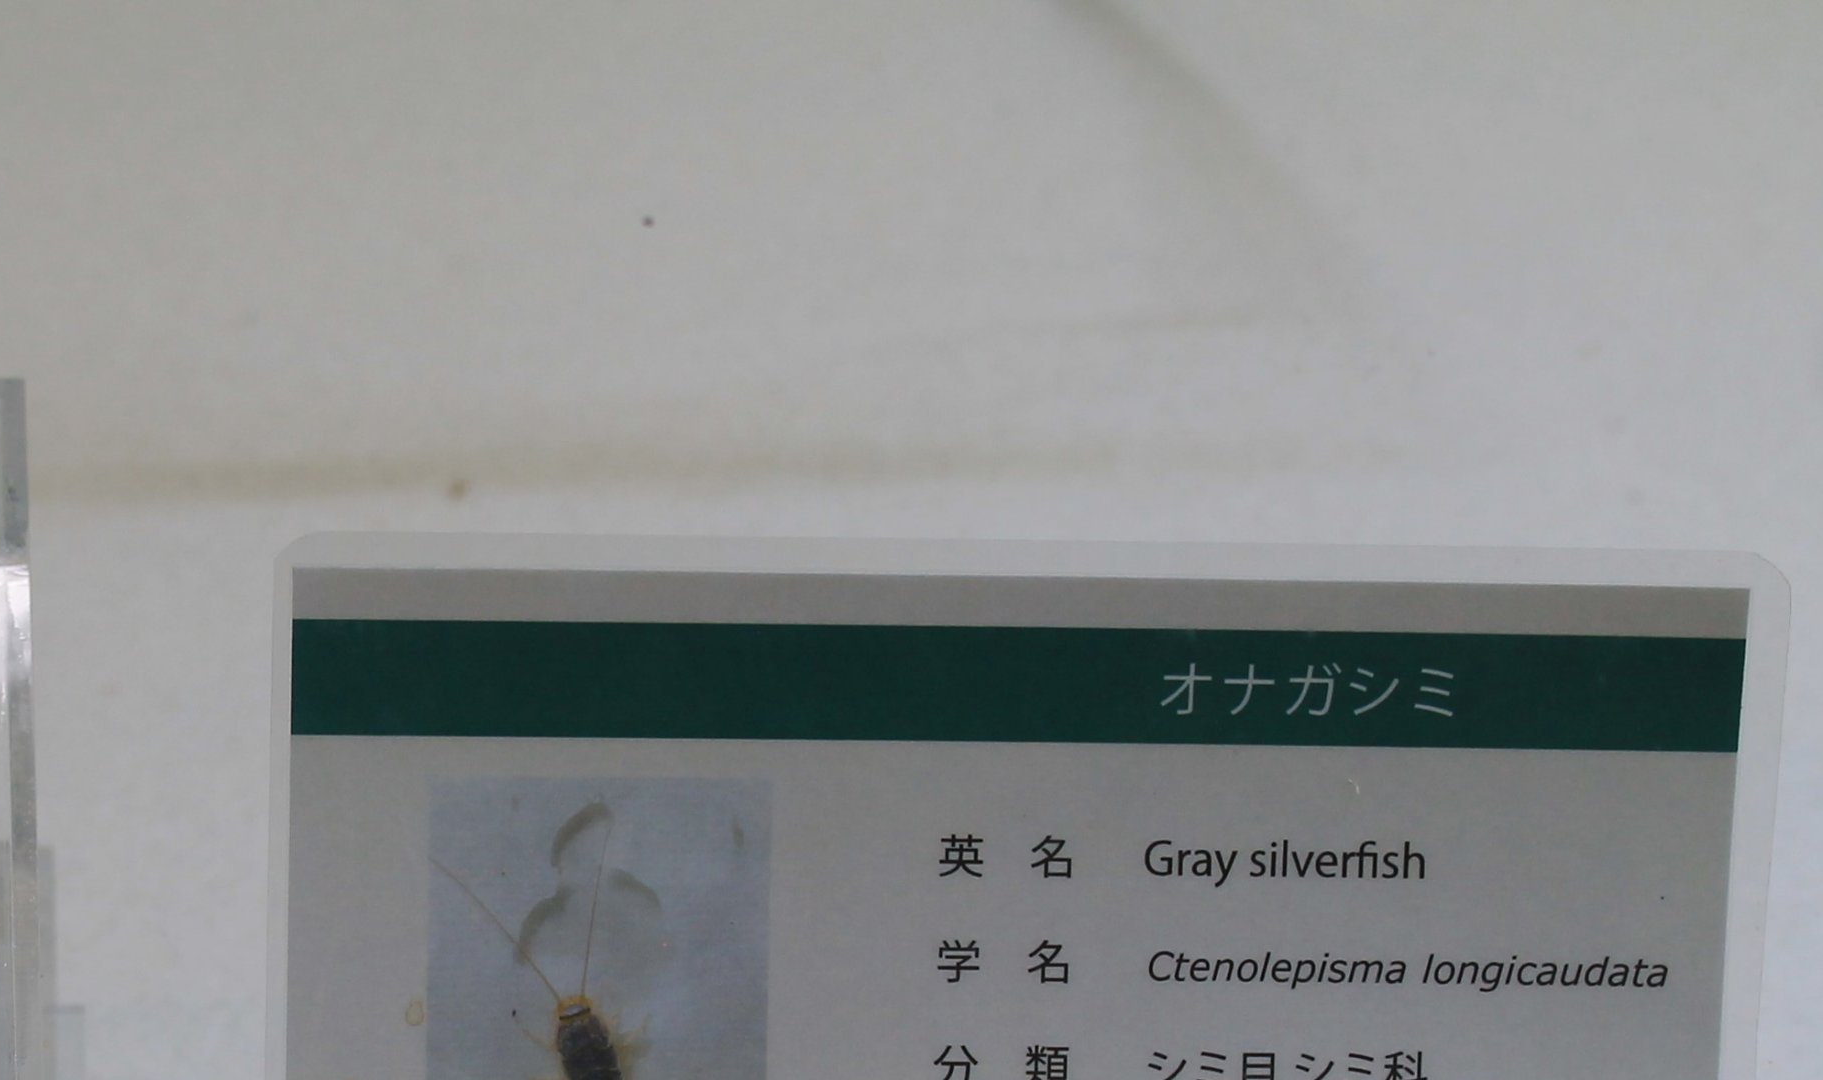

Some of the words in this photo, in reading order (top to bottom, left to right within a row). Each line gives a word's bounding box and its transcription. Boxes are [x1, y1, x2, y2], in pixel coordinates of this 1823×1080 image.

[1160, 662, 1454, 717] オナガシミ
[1144, 839, 1238, 888] Gray
[1249, 839, 1426, 880] silverfish
[1148, 950, 1407, 990] Ctenolepisma
[1422, 953, 1669, 993] longicaudata
